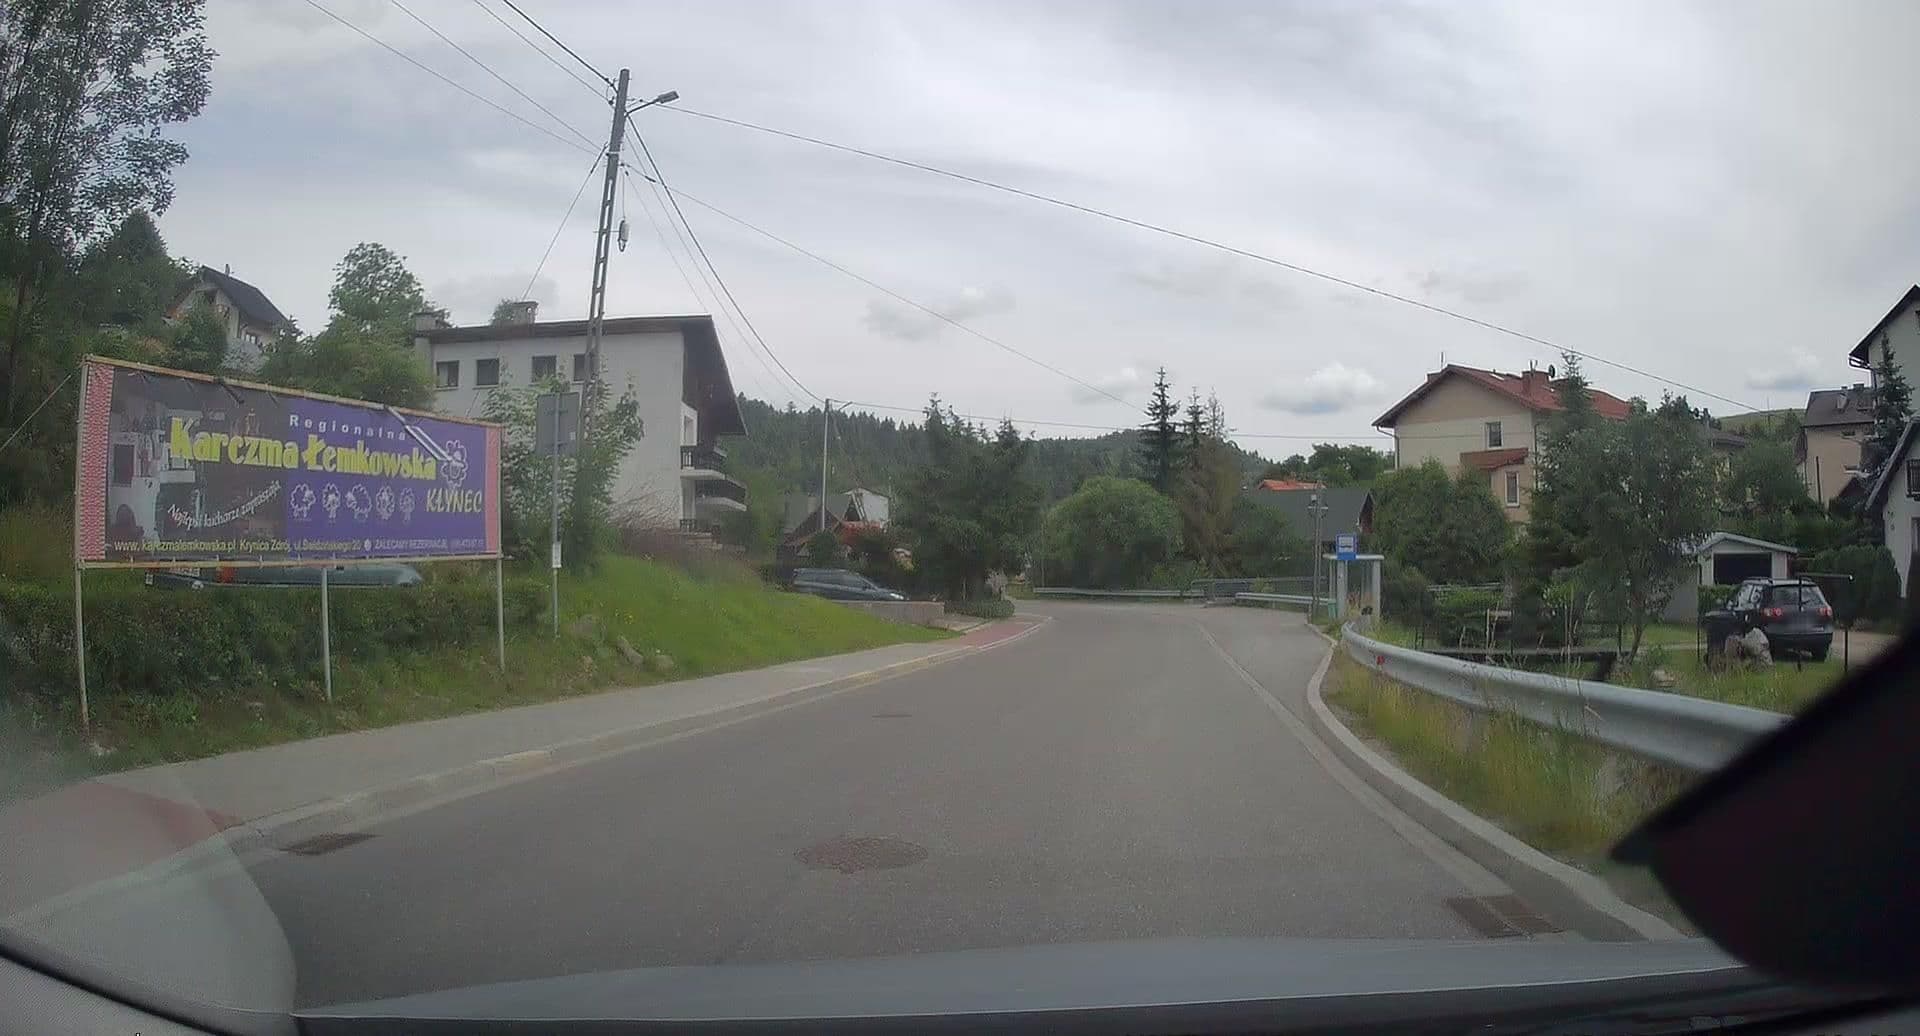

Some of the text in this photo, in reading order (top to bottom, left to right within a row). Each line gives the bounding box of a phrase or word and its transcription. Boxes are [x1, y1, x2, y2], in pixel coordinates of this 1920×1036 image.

[289, 414, 407, 441] Regionalna
[170, 417, 437, 480] Karczma Łemkowska
[426, 487, 482, 513] KŁYNEC
